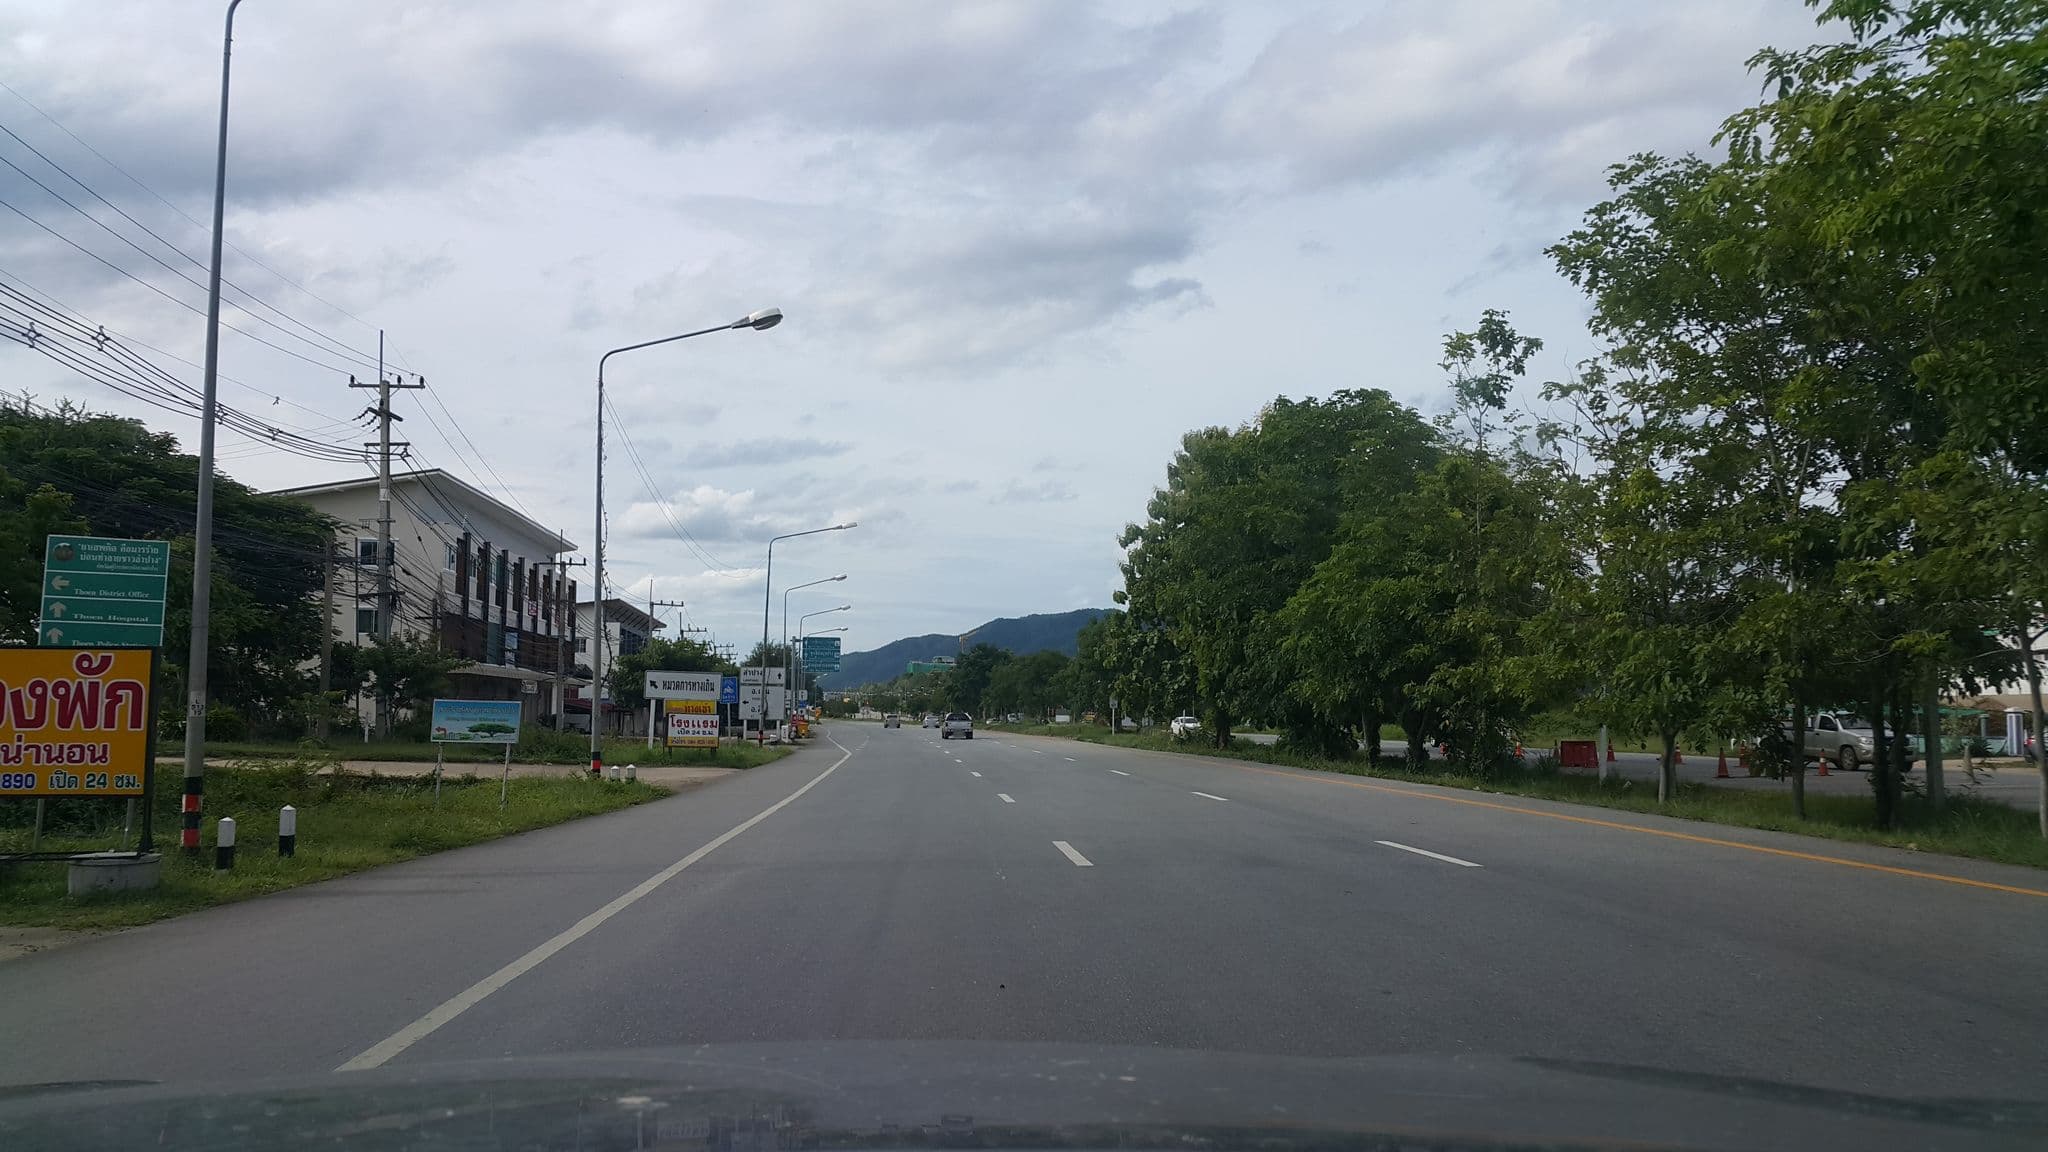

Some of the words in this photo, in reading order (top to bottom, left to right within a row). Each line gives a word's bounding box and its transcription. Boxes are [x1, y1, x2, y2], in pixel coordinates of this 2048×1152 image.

[99, 589, 126, 598] District
[128, 590, 151, 599] Office
[108, 615, 149, 623] Hospital
[0, 651, 146, 731] งพัก
[671, 714, 718, 729] โรงแรม
[677, 727, 690, 735] เปิด
[48, 769, 79, 790] เปิด
[85, 772, 108, 790] 24
[114, 773, 141, 790] ชม.
